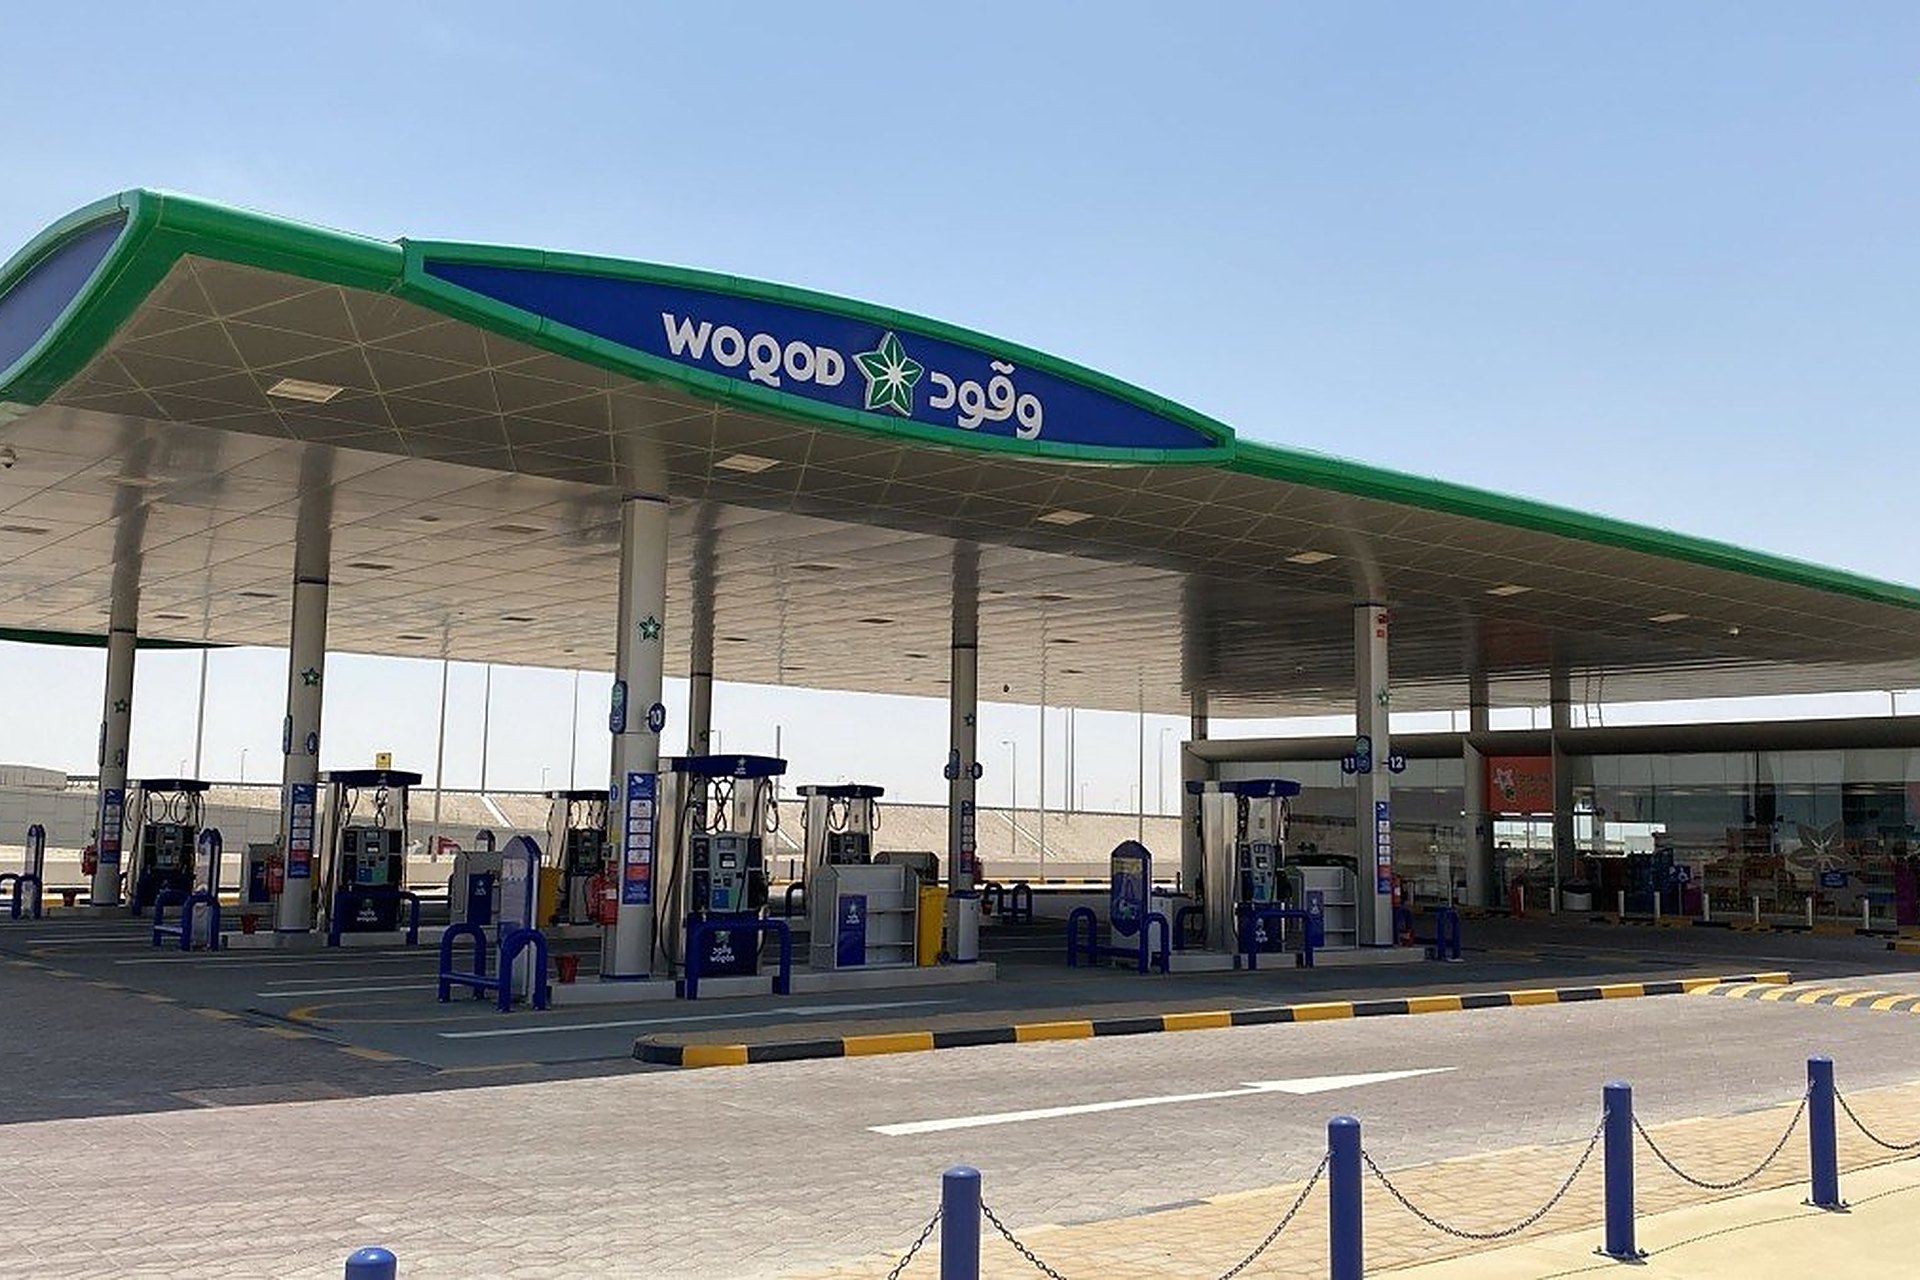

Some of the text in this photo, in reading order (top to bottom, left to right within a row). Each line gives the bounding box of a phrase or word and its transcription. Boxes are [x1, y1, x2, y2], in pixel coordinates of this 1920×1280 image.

[661, 312, 845, 387] WOQOD
[929, 361, 1043, 440] وقود
[1344, 758, 1355, 769] 11
[1390, 756, 1403, 769] 12
